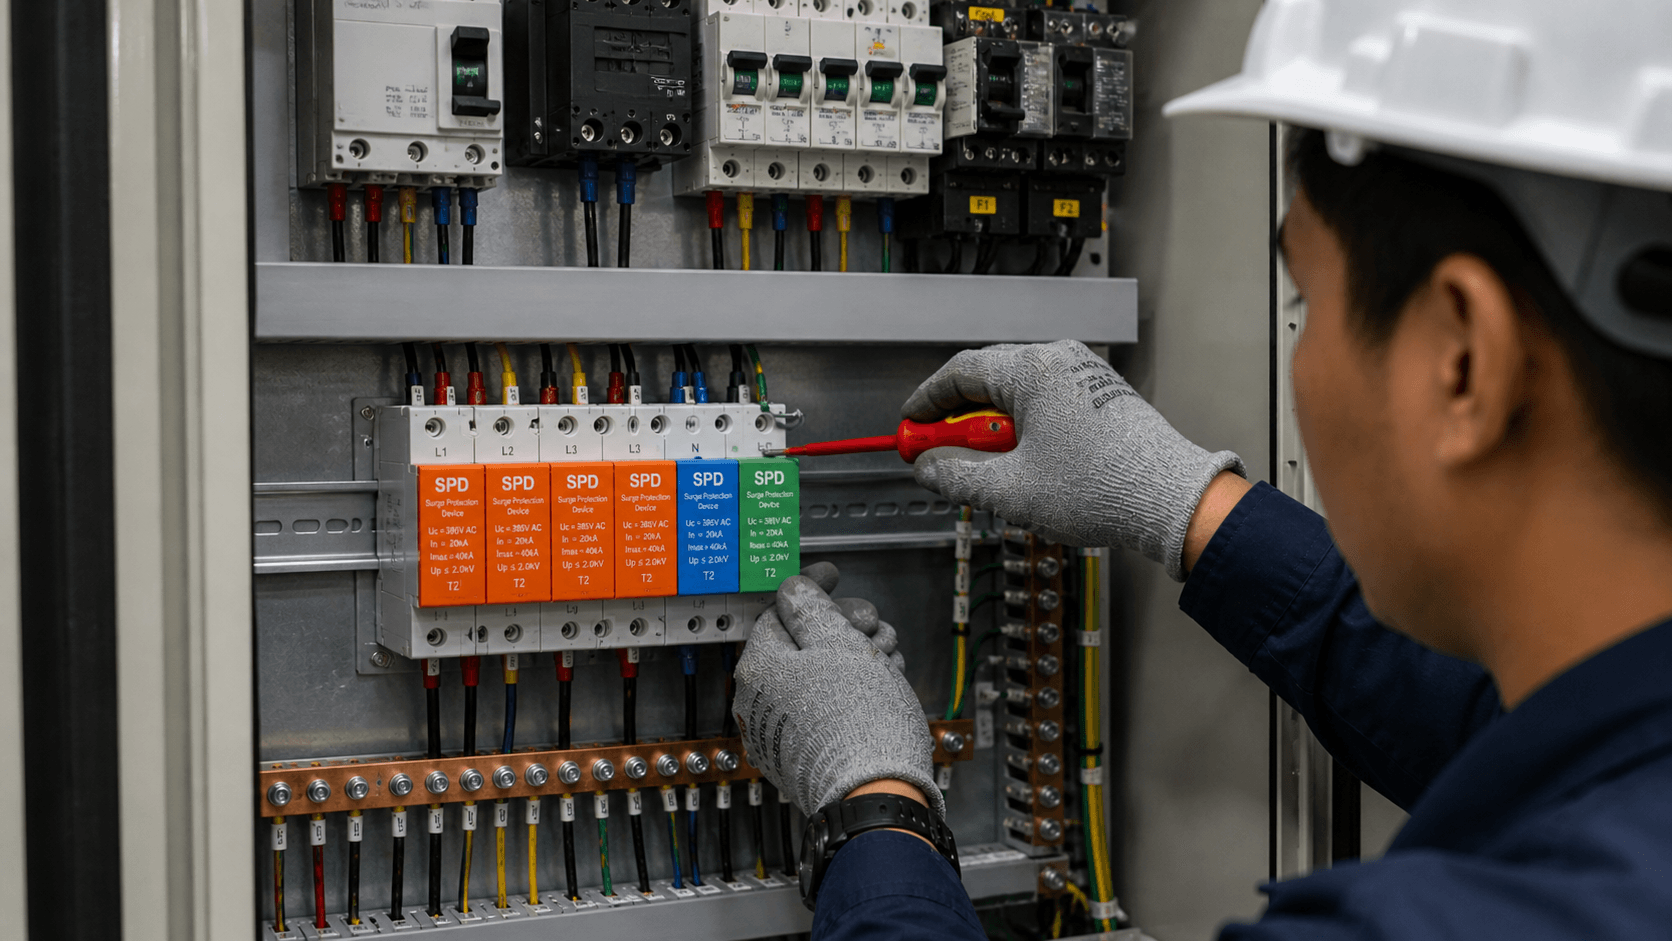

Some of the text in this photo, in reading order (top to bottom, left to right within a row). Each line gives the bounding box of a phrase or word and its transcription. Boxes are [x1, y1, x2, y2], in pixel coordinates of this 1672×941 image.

[977, 200, 988, 210] F1
[436, 447, 446, 456] L1
[502, 447, 513, 455] L2
[566, 445, 577, 454] L3
[629, 444, 640, 453] L3
[692, 443, 699, 452] N
[567, 475, 598, 488] SPD
[630, 474, 661, 487] SPD
[693, 472, 723, 486] SPD
[755, 471, 784, 485] SPD
[435, 477, 469, 492] SPD
[502, 476, 534, 490] SPD
[626, 559, 636, 568] Up
[689, 557, 699, 565] Up
[750, 555, 760, 563] Up
[497, 564, 508, 572] Up
[562, 561, 572, 571] Up
[431, 567, 441, 576] Up
[703, 571, 714, 580] T2
[765, 568, 776, 577] T2
[514, 578, 525, 587] T2
[578, 576, 589, 585] T2
[641, 574, 652, 582] T2
[447, 581, 459, 590] T2
